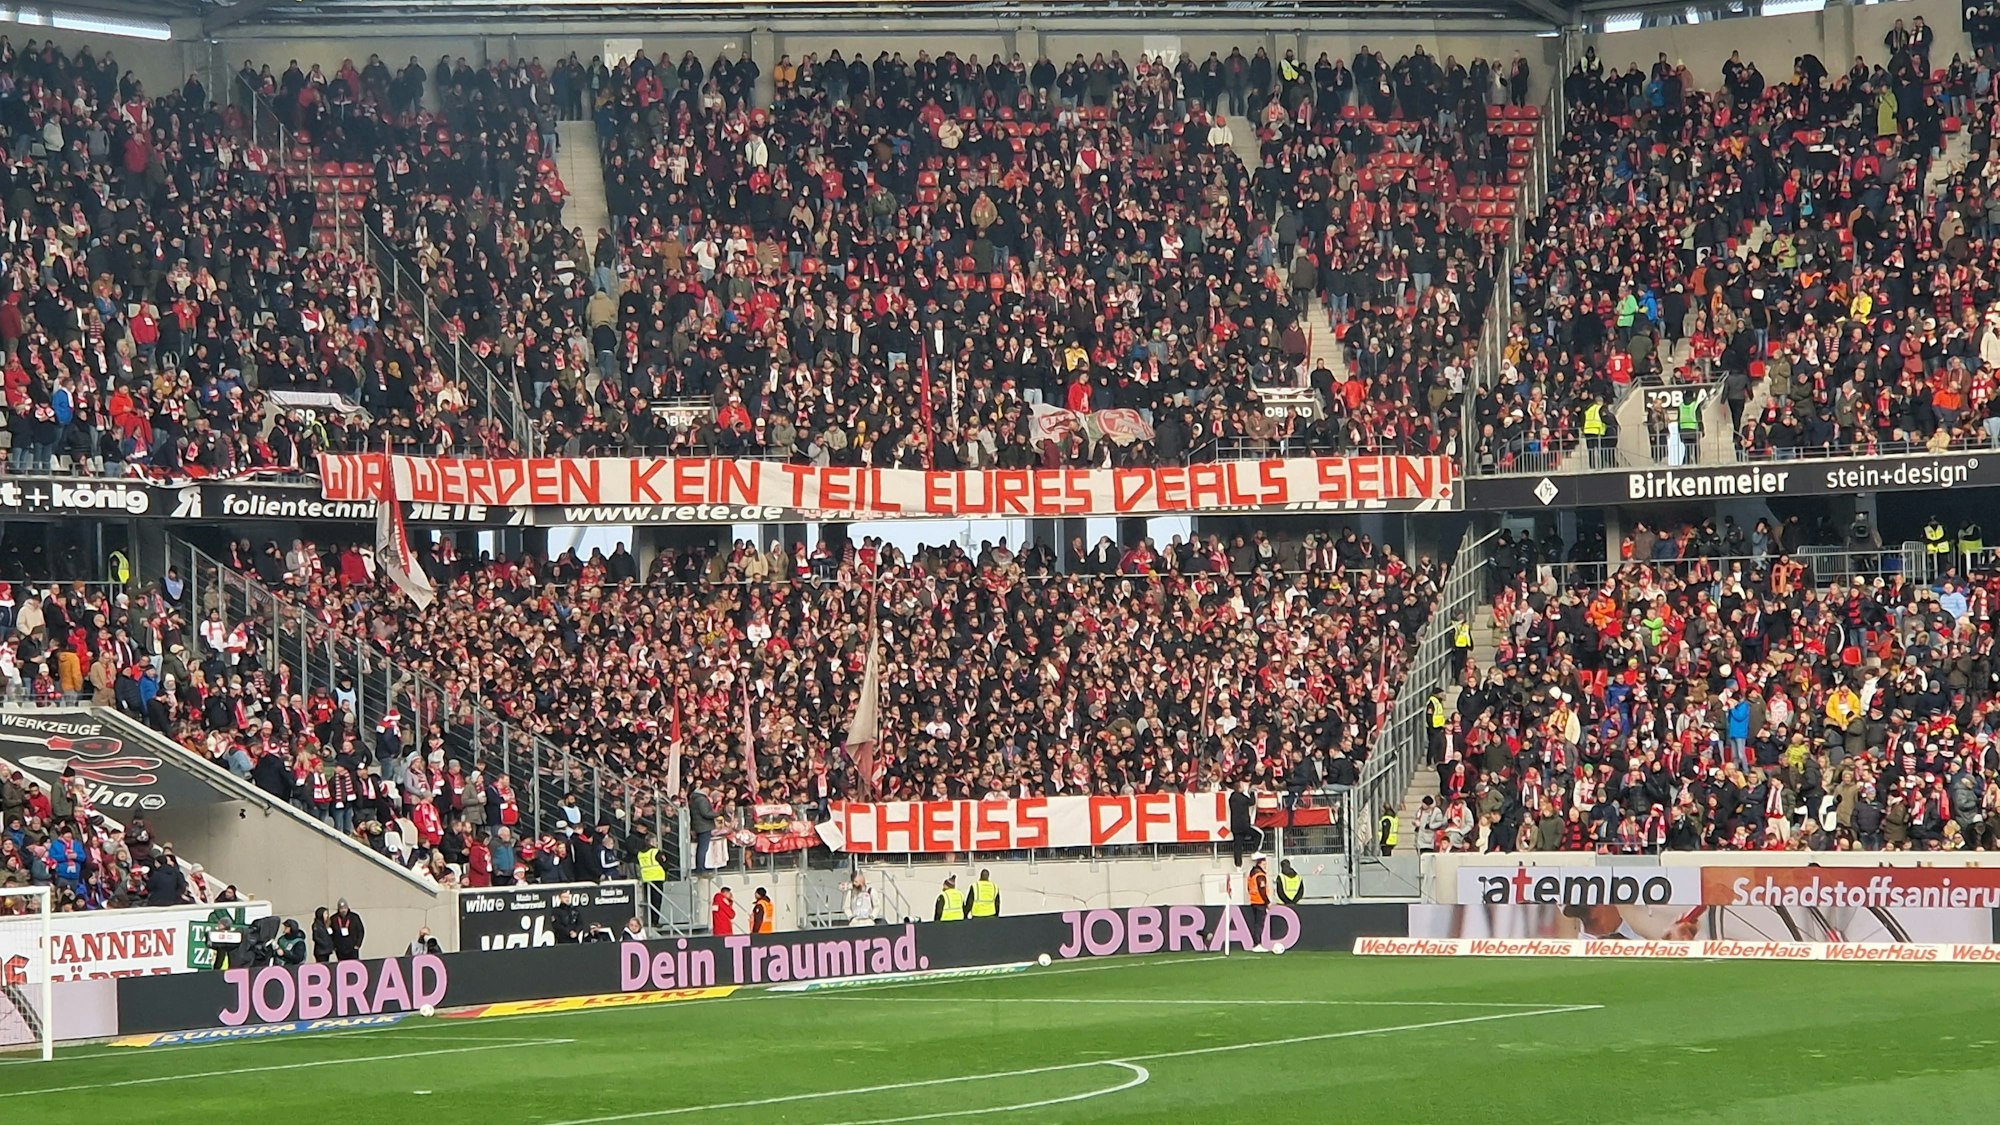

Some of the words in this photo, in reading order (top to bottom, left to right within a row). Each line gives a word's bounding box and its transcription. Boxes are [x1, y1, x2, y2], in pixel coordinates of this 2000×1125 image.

[320, 453, 387, 499] WIR
[405, 457, 600, 504] WERDEN
[630, 458, 759, 506] KEIN
[782, 465, 901, 512] TEIL
[924, 470, 1091, 514] EURES
[1113, 462, 1288, 511] DEALS
[1317, 456, 1452, 500] SEIN!
[1629, 467, 1790, 499] Birkenmeier
[223, 494, 380, 519] folientechni
[1, 714, 102, 736] WERKZEUGE
[86, 783, 140, 808] iha
[1089, 793, 1231, 845] DFL!
[1479, 868, 1672, 904] atempo
[1059, 905, 1301, 960] JOBRAD
[1360, 939, 1458, 955] WeberHaus
[1470, 940, 1572, 956] WeberHaus
[1584, 941, 1690, 957] WeberHaus
[1702, 941, 1812, 958] WeberHaus
[1825, 943, 1938, 960] WeberHaus
[620, 938, 716, 992] Dein
[724, 922, 931, 985] Traumrad.
[218, 953, 448, 1027] JOBRAD
[158, 1024, 297, 1042] EUROPA
[307, 1015, 395, 1029] PARK
